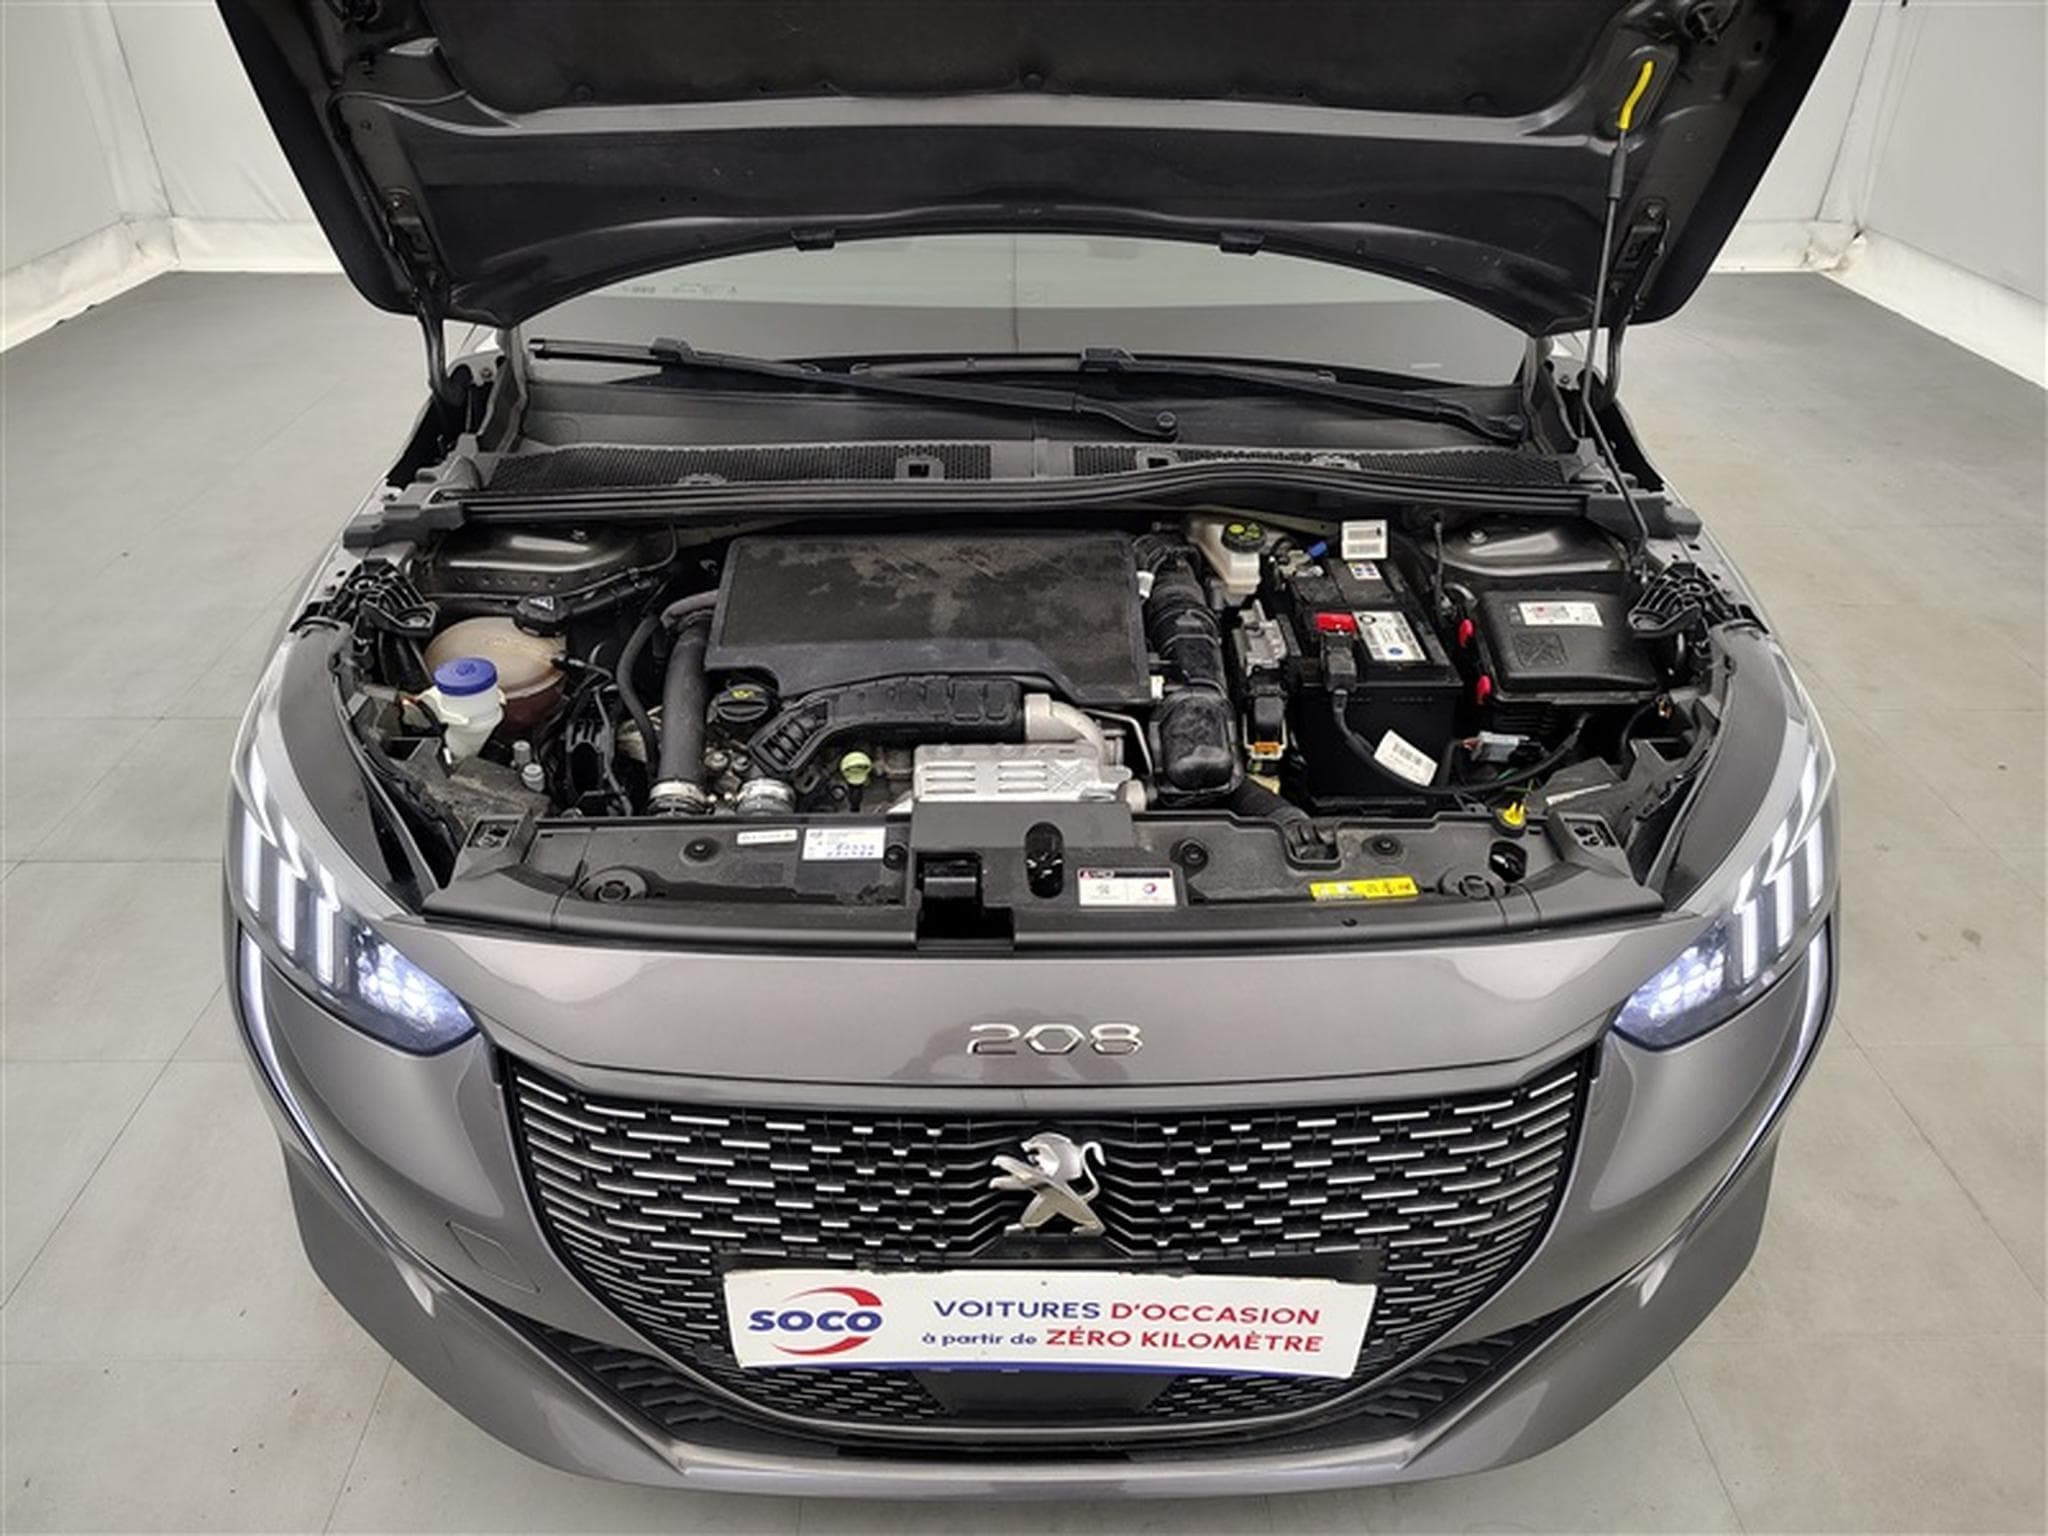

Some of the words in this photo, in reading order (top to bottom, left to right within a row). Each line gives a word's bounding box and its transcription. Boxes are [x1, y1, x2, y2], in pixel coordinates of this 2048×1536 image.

[966, 1022, 1144, 1055] 208
[748, 1309, 883, 1333] SOCO
[932, 1300, 1101, 1320] VOITURES
[1110, 1302, 1321, 1325] D'OCCASION
[921, 1332, 936, 1346] à
[941, 1331, 1004, 1347] partir
[1010, 1333, 1038, 1346] de
[1045, 1326, 1133, 1347] ZÉRO
[1140, 1329, 1324, 1353] KILOMÈTRE
